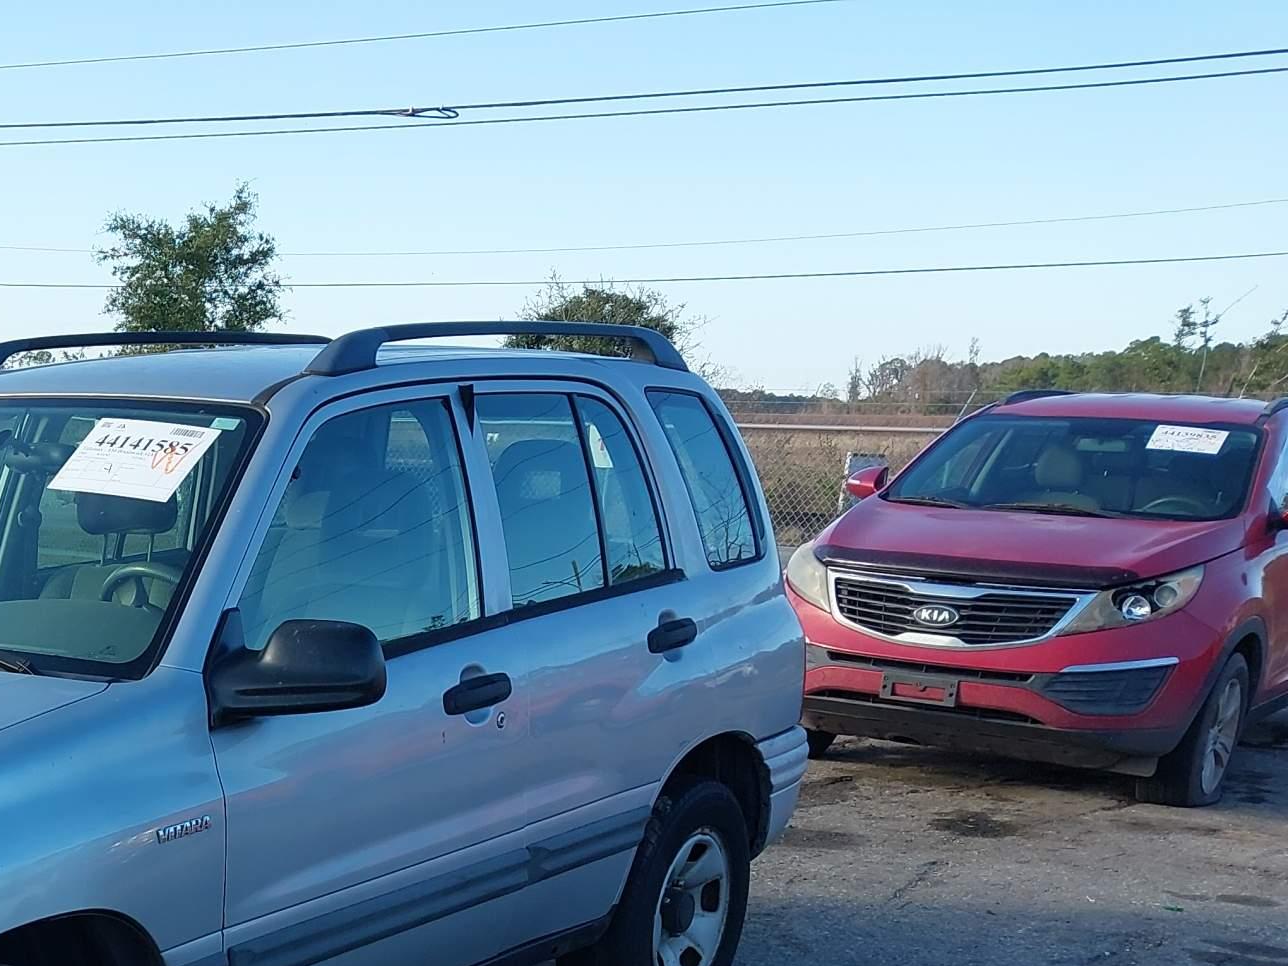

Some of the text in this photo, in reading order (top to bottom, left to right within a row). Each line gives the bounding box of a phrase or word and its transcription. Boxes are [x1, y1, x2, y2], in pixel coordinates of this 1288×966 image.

[95, 433, 194, 456] 44141585
[920, 608, 950, 622] KIA
[156, 815, 211, 844] VITARA
